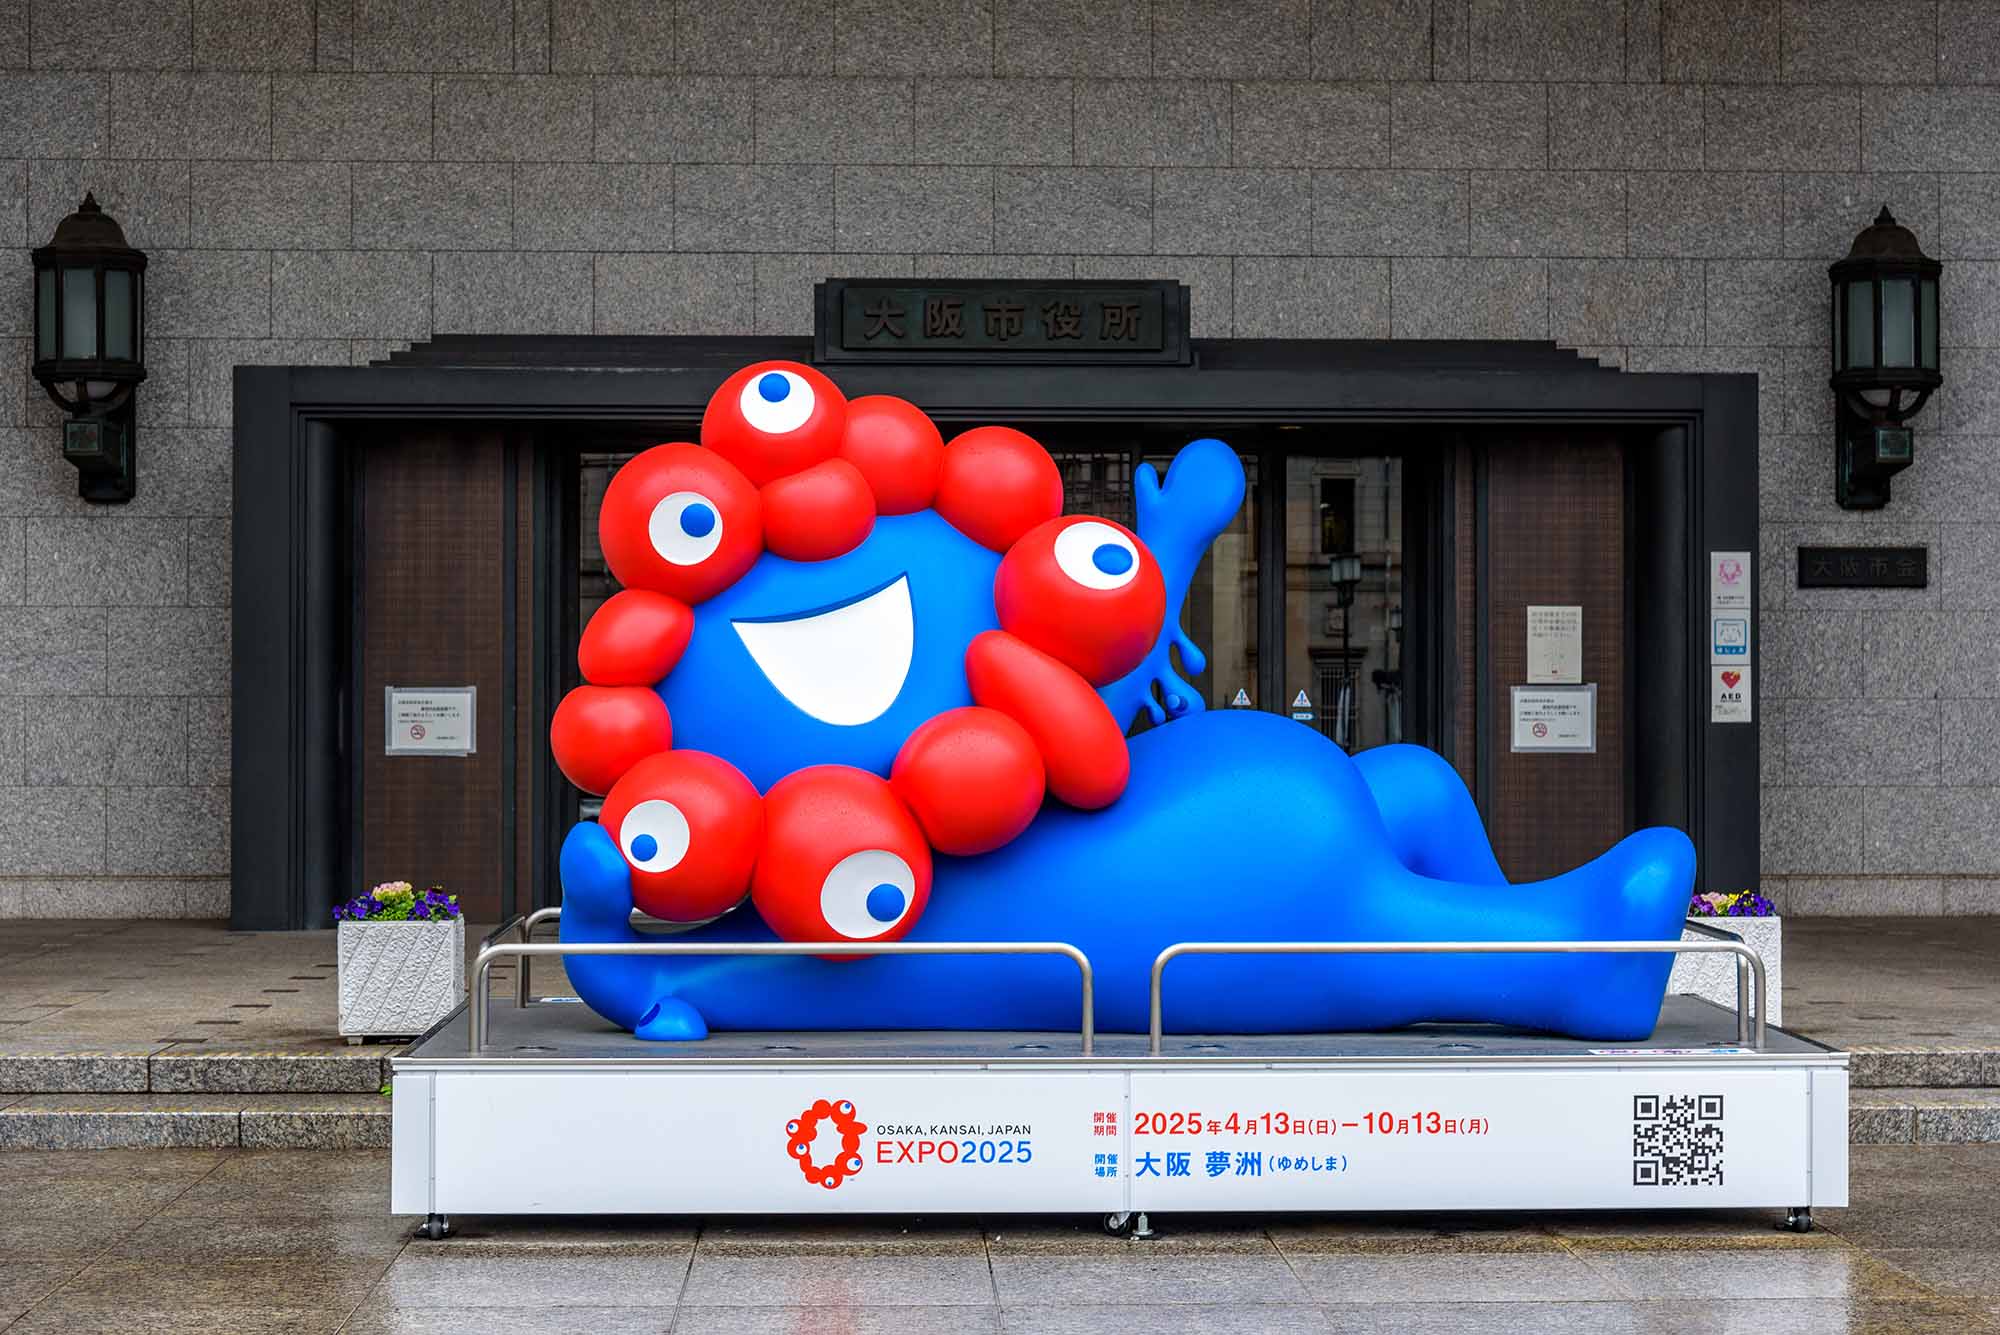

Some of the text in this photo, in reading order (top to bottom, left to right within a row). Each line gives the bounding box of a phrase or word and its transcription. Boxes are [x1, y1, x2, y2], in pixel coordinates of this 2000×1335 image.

[863, 299, 1142, 342] 大阪市役所
[1720, 692, 1742, 701] AED
[1093, 1111, 1117, 1123] 開催
[876, 1124, 1031, 1137] OSAKA, KANSAI, JAPAN
[1093, 1125, 1117, 1136] 期間
[876, 1139, 1033, 1164] EXPO2025
[1094, 1153, 1118, 1165] 開催
[1135, 1151, 1192, 1177] 大阪
[1094, 1166, 1118, 1178] 場所
